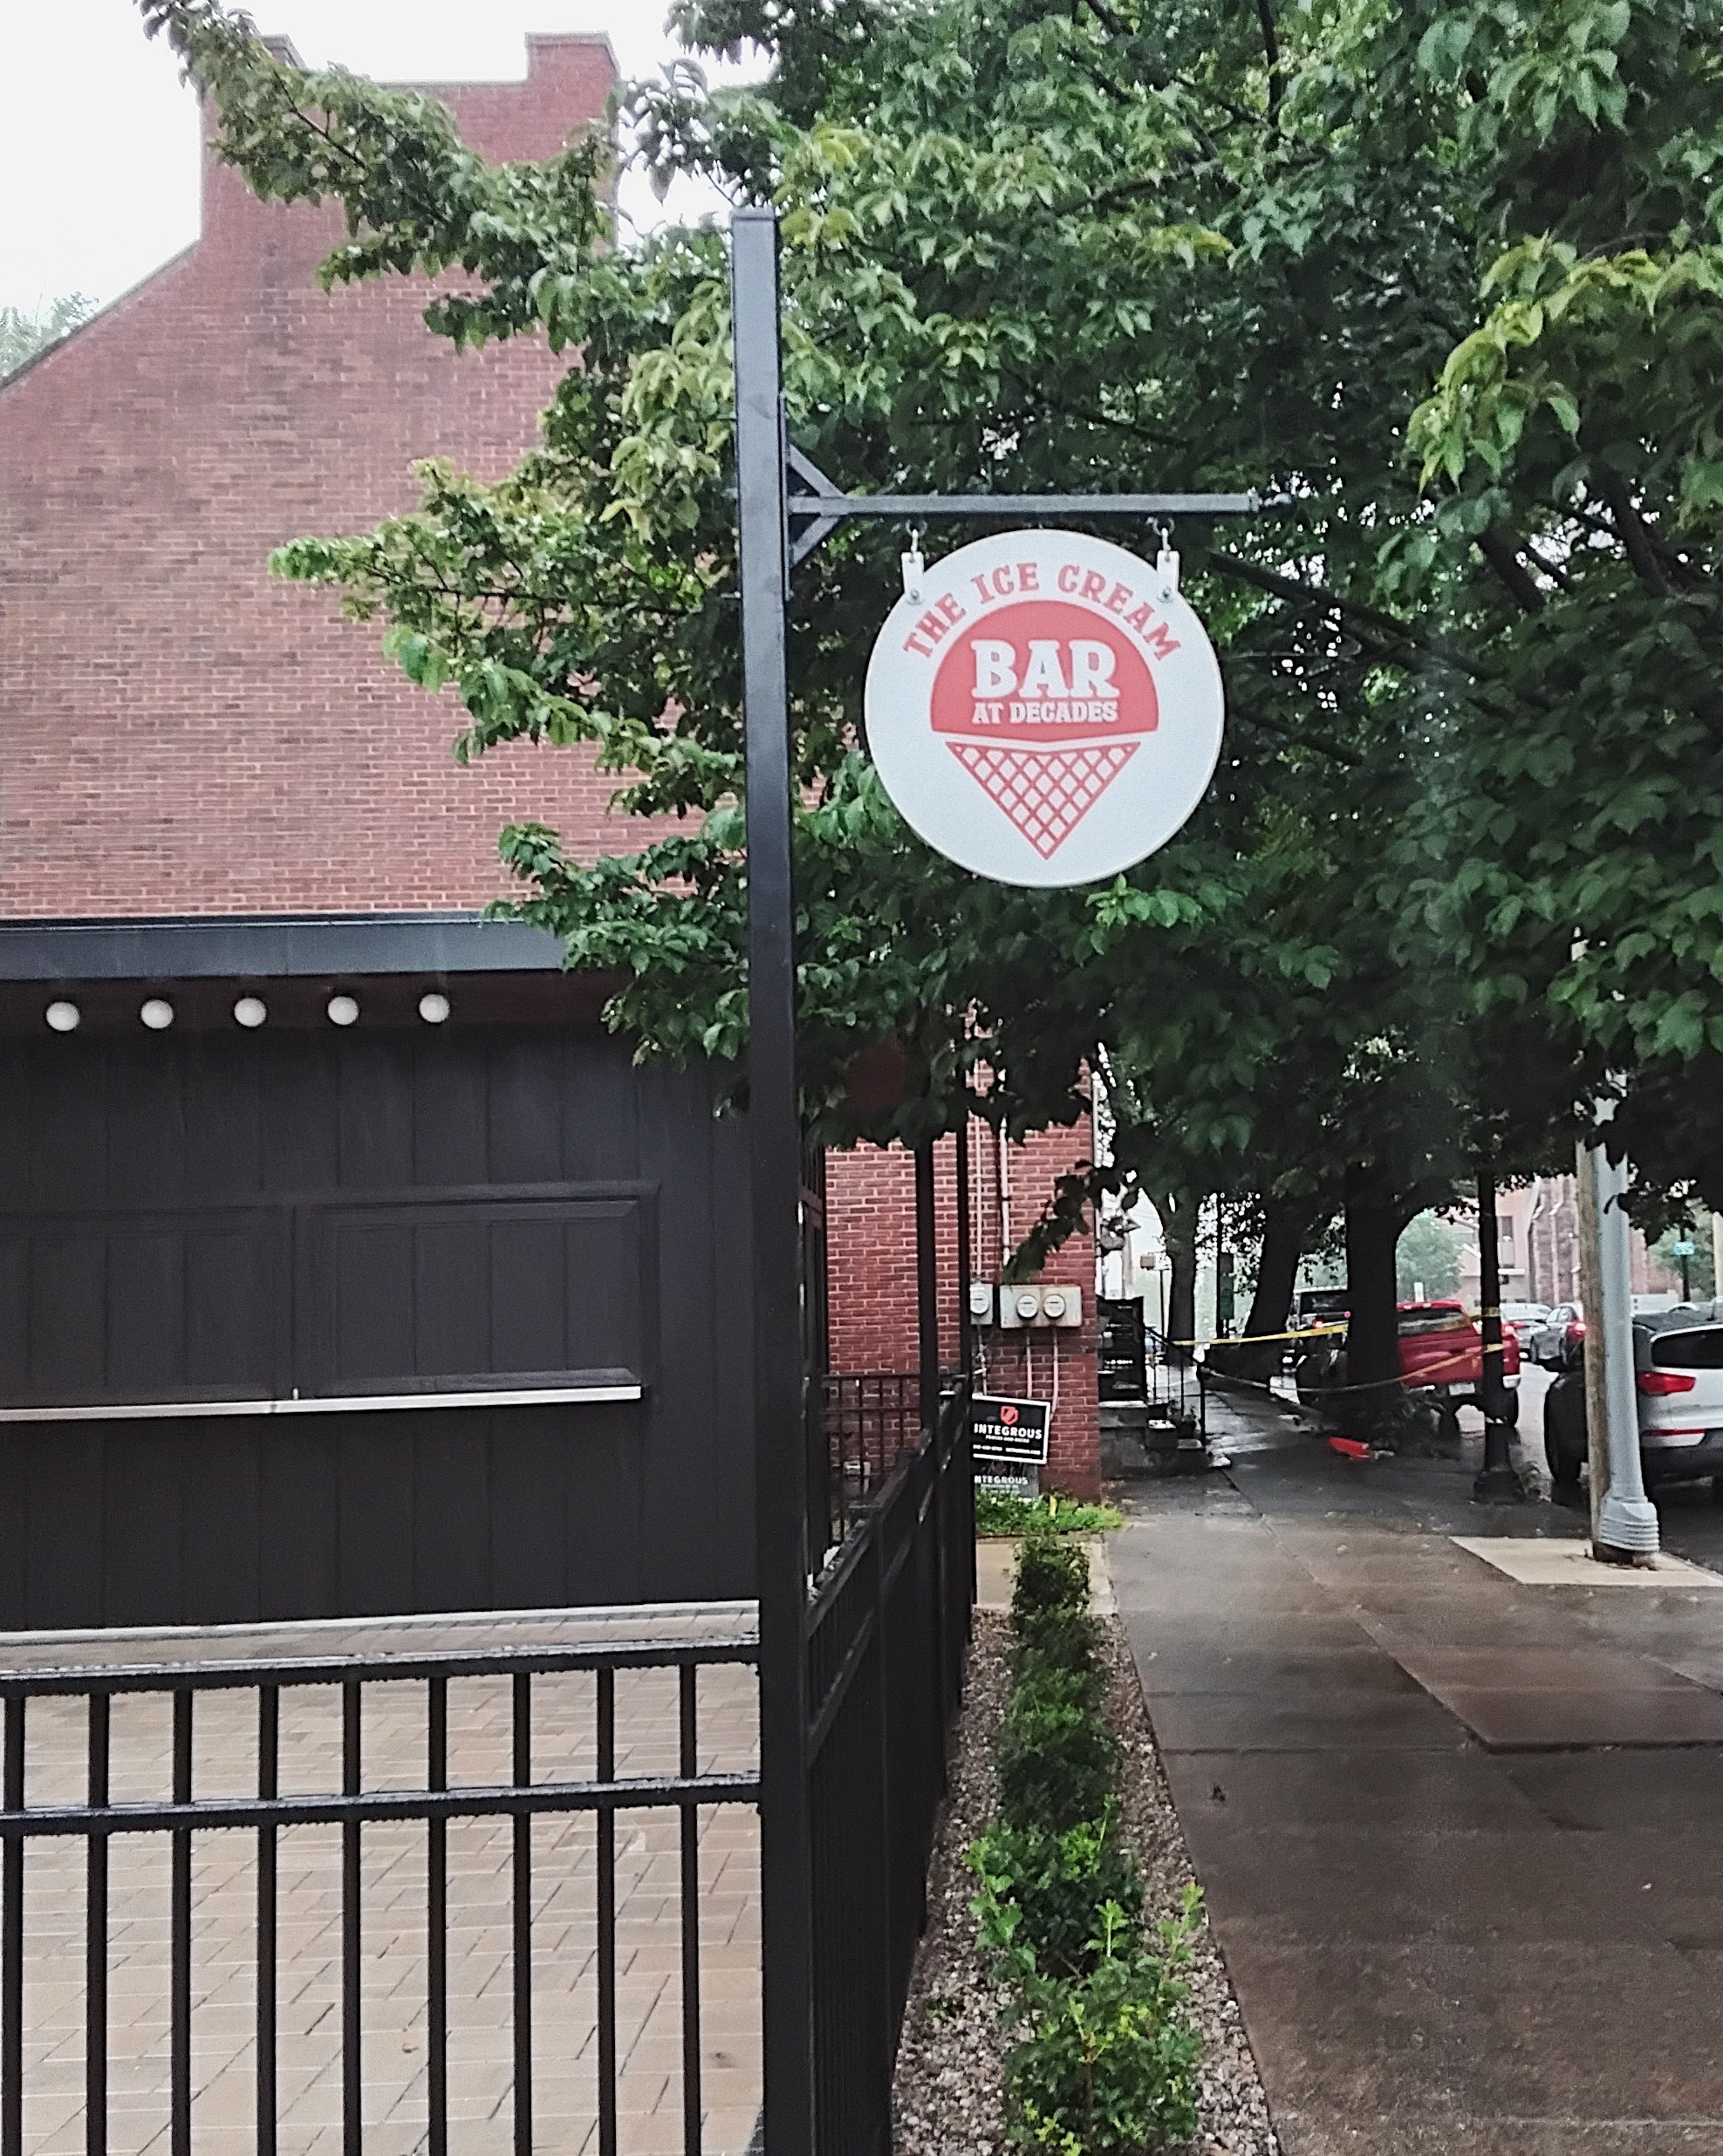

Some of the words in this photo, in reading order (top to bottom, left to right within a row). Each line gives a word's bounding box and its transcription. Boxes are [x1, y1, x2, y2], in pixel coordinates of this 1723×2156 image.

[903, 594, 966, 658] THE
[972, 563, 1039, 604] ICE
[1058, 565, 1180, 660] CREAM
[971, 639, 1119, 697] BAR
[972, 703, 1003, 724] AT
[1010, 701, 1118, 722] DECADES
[974, 1423, 1042, 1439] INTEGROUS
[974, 1475, 1029, 1484] NTEGROUS
